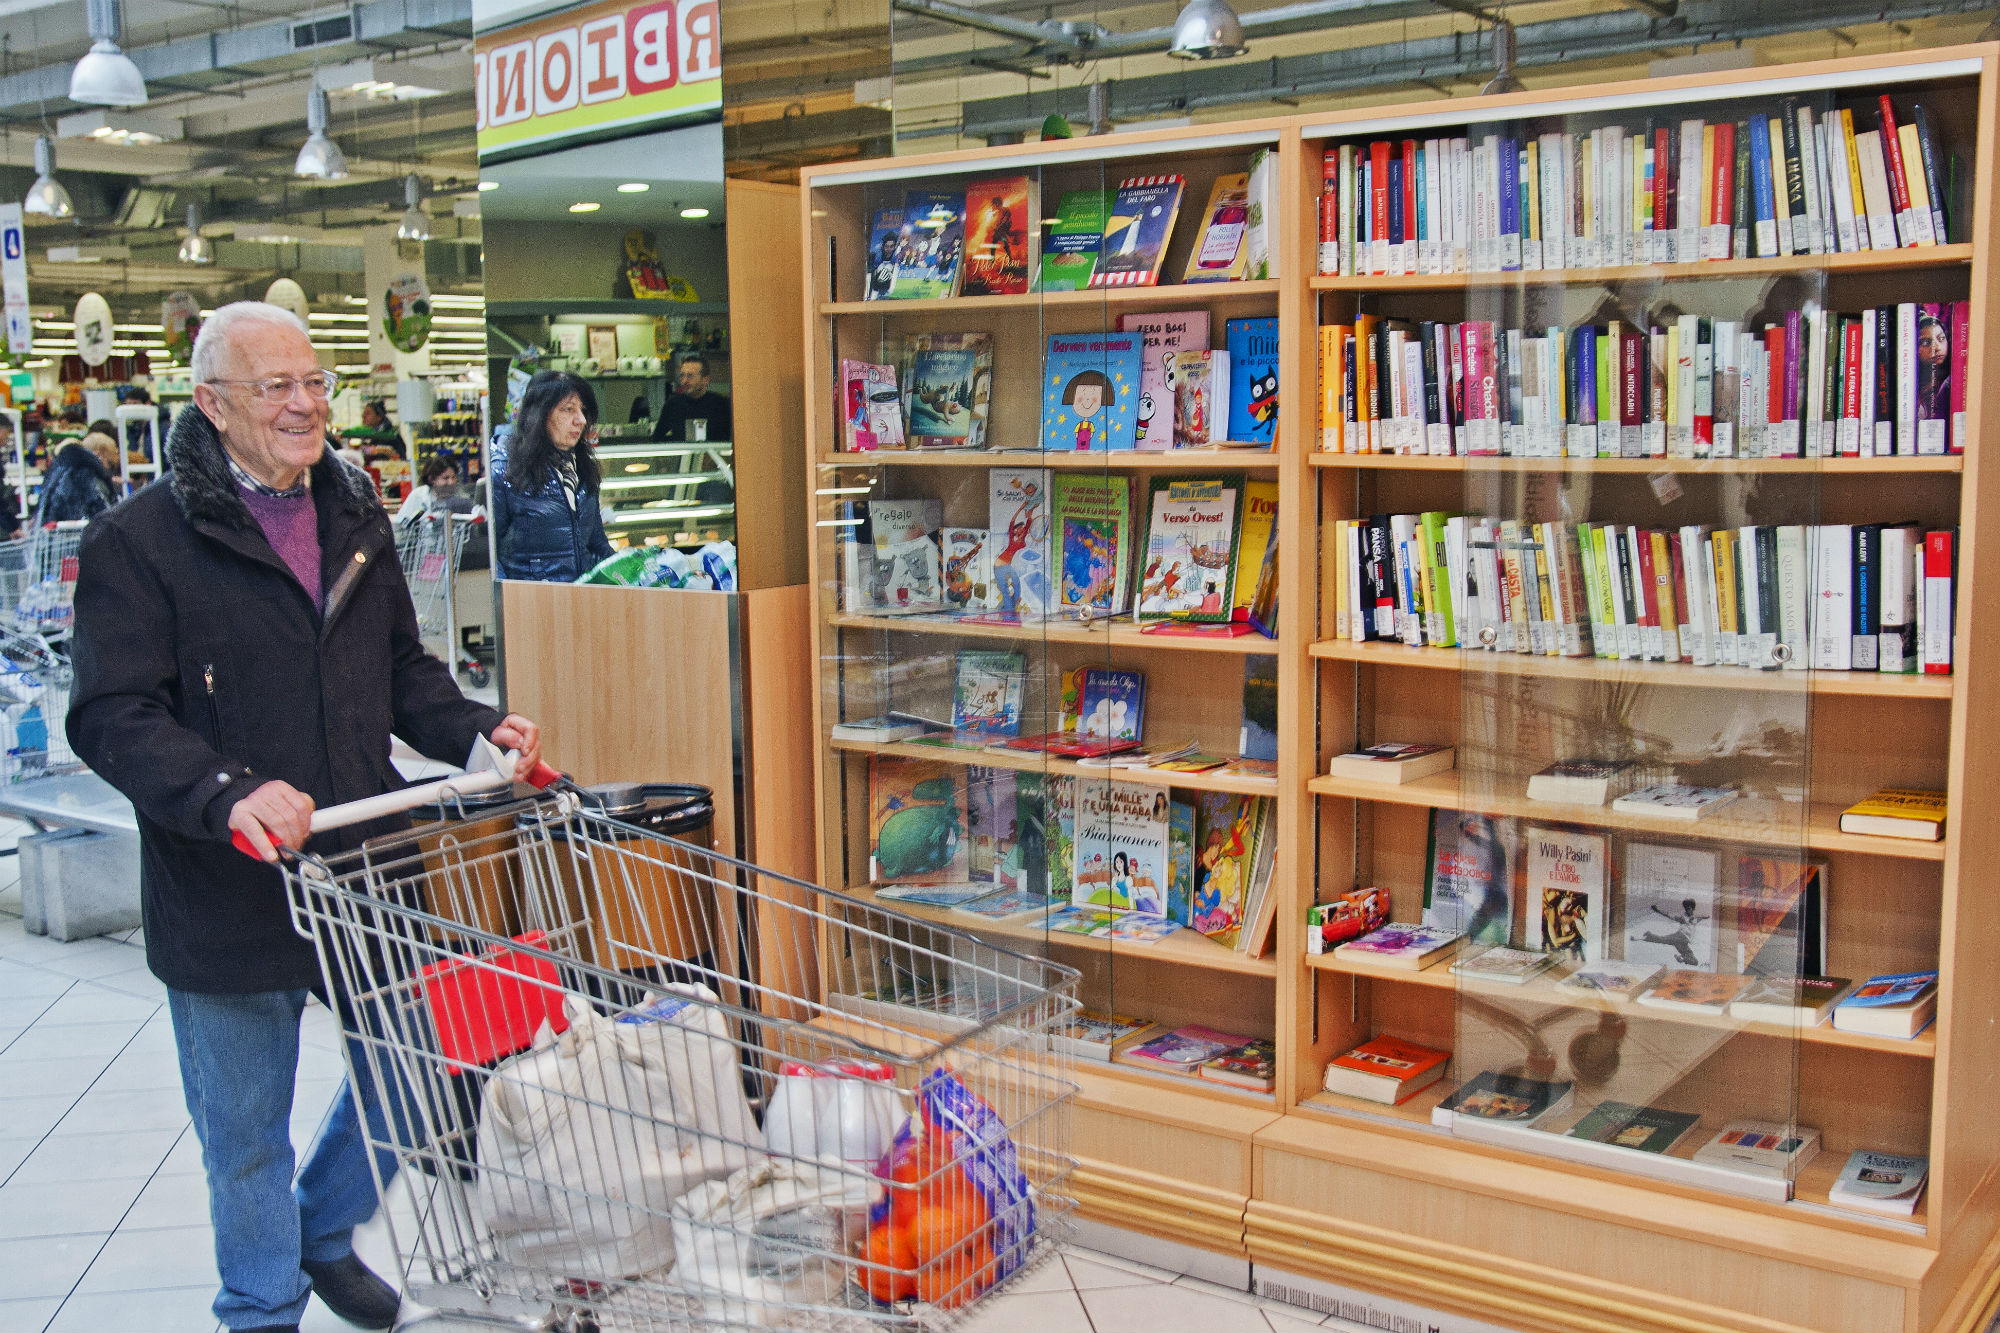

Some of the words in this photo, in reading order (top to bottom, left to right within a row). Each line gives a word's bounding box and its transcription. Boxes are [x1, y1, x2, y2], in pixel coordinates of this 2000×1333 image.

[1786, 157, 1801, 203] DIANA
[1128, 187, 1169, 197] GABBIANELLA
[1140, 195, 1156, 203] FARO
[1137, 323, 1161, 333] ZERO
[1144, 337, 1160, 347] PER
[1164, 336, 1181, 346] ME!
[1467, 330, 1476, 345] Lilli
[1052, 340, 1087, 352] Davvero
[1247, 357, 1255, 366] le
[1467, 347, 1476, 376] Gruber
[1848, 367, 1855, 375] LA
[1370, 389, 1378, 417] BUDDHA
[1483, 376, 1494, 419] Chador
[879, 509, 912, 522] regalo
[1163, 512, 1190, 523] Verso
[1192, 512, 1224, 522] Ovest!
[892, 522, 916, 530] diverso
[1371, 527, 1381, 563] PANSA
[1507, 559, 1516, 568] LA
[1508, 566, 1520, 598] CASTA
[1782, 555, 1793, 599] QUESTO
[1099, 790, 1113, 802] LE
[1114, 791, 1143, 805] MILLE
[1090, 801, 1097, 810] E
[1098, 801, 1121, 814] UNA
[1123, 803, 1152, 818] FIABA
[1081, 824, 1162, 849] Biancaneve
[1439, 849, 1451, 862] La
[1540, 842, 1563, 862] Willy
[1566, 846, 1592, 863] Pasini
[1437, 863, 1492, 881] metabolica
[1555, 863, 1560, 872] IL
[1561, 864, 1576, 874] CIBO
[1556, 870, 1581, 884] L'AMORE
